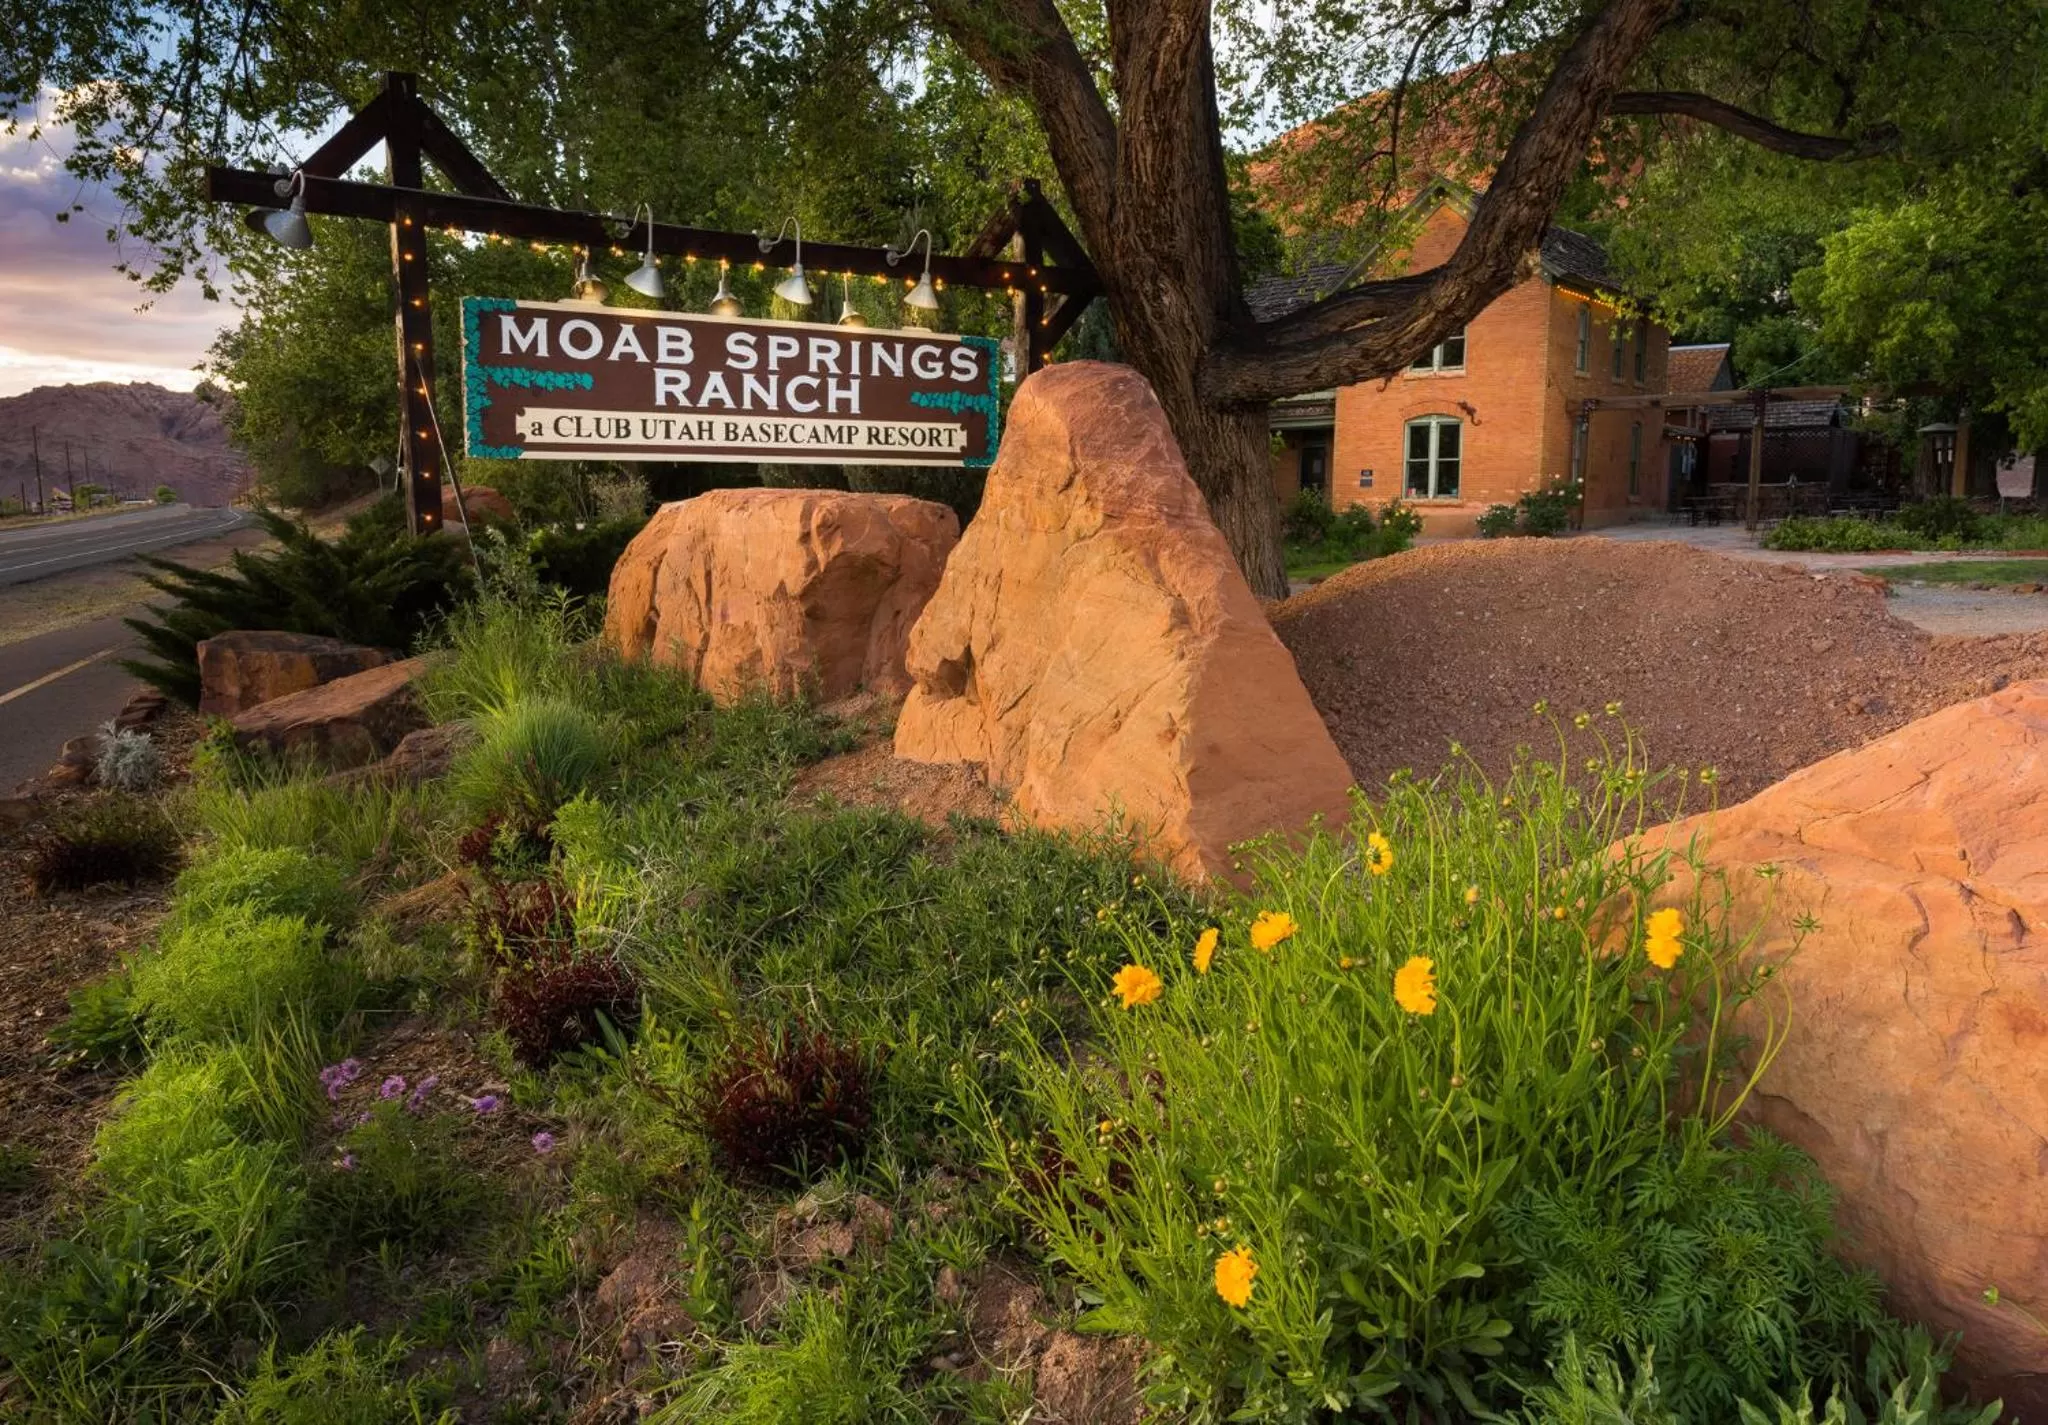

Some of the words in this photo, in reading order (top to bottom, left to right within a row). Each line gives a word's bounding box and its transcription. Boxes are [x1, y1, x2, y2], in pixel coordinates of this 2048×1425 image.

[499, 314, 695, 365] MOAB
[725, 331, 980, 382] SPRINGS
[653, 367, 861, 414] RANCH
[530, 421, 545, 437] a
[553, 415, 632, 440] CLUB
[640, 418, 716, 442] UTAH
[723, 421, 860, 446] BASECAMP
[866, 425, 958, 448] RESORT
